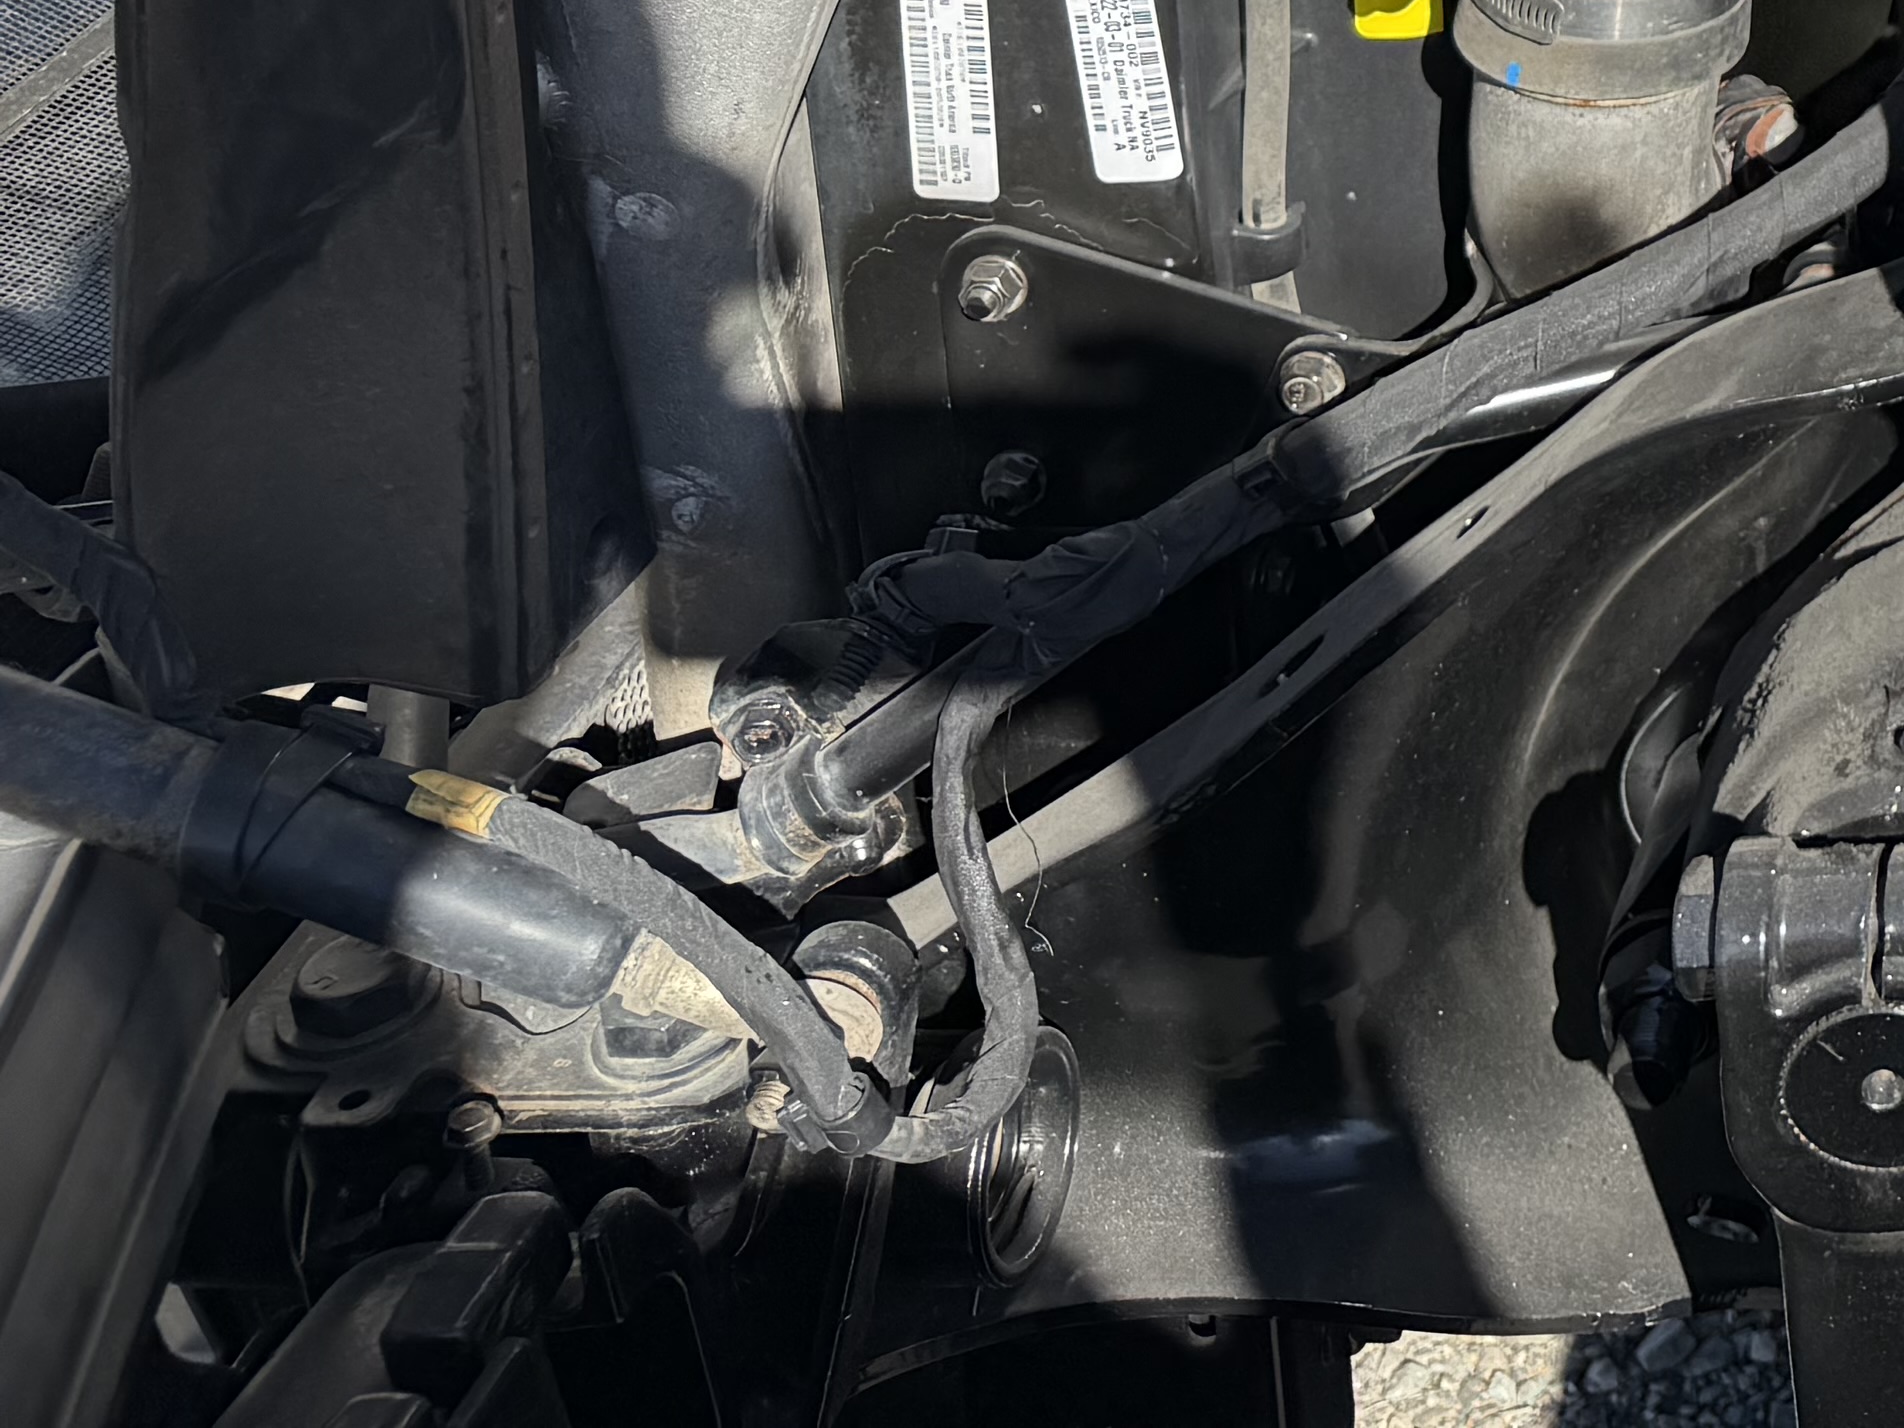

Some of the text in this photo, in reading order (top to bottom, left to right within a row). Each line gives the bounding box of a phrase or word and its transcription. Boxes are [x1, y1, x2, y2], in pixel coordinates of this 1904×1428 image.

[1114, 59, 1130, 101] Daimler
[1121, 104, 1135, 134] Truck
[1138, 110, 1156, 162] NV9035
[1115, 142, 1127, 152] A
